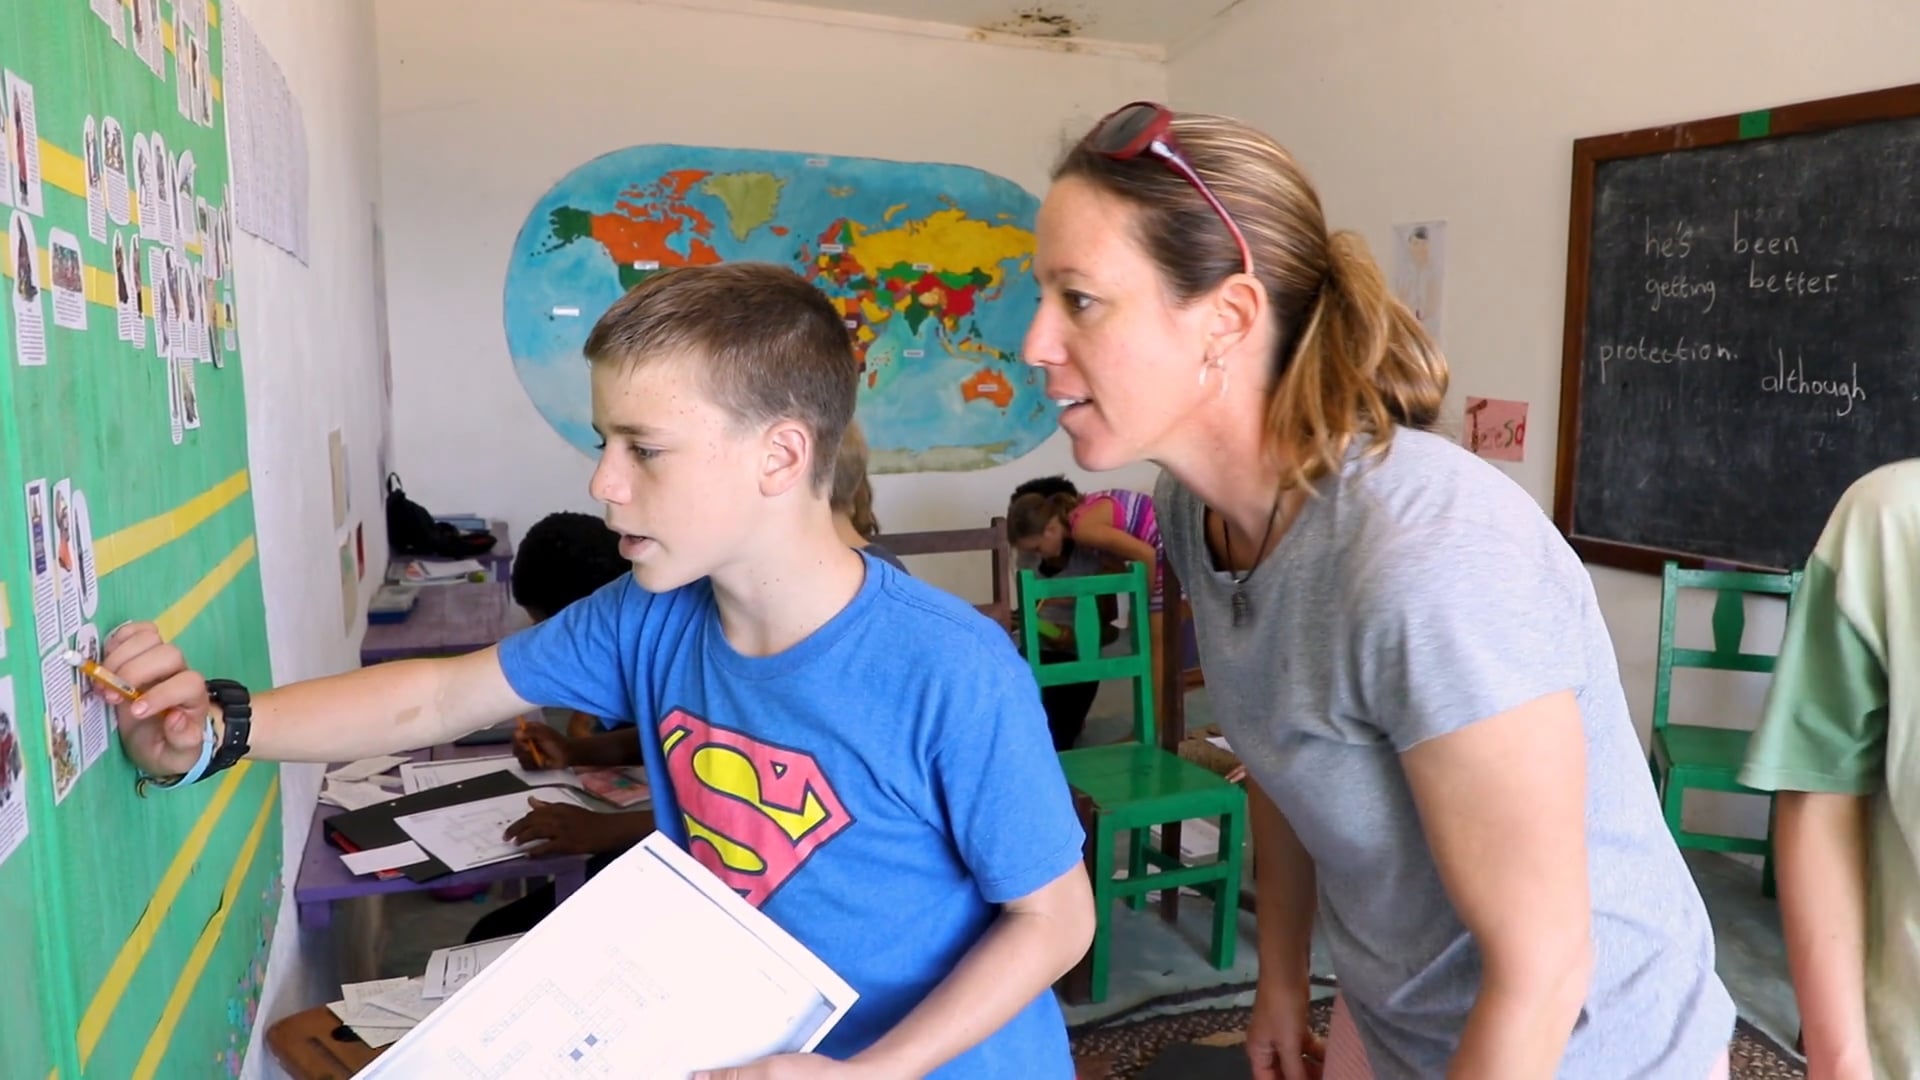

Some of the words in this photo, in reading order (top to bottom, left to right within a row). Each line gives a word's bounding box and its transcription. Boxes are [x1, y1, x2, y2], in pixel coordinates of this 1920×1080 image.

[1645, 215, 1693, 258] he's
[1733, 209, 1799, 255] been
[1645, 264, 1716, 314] getting
[1761, 348, 1866, 416] although
